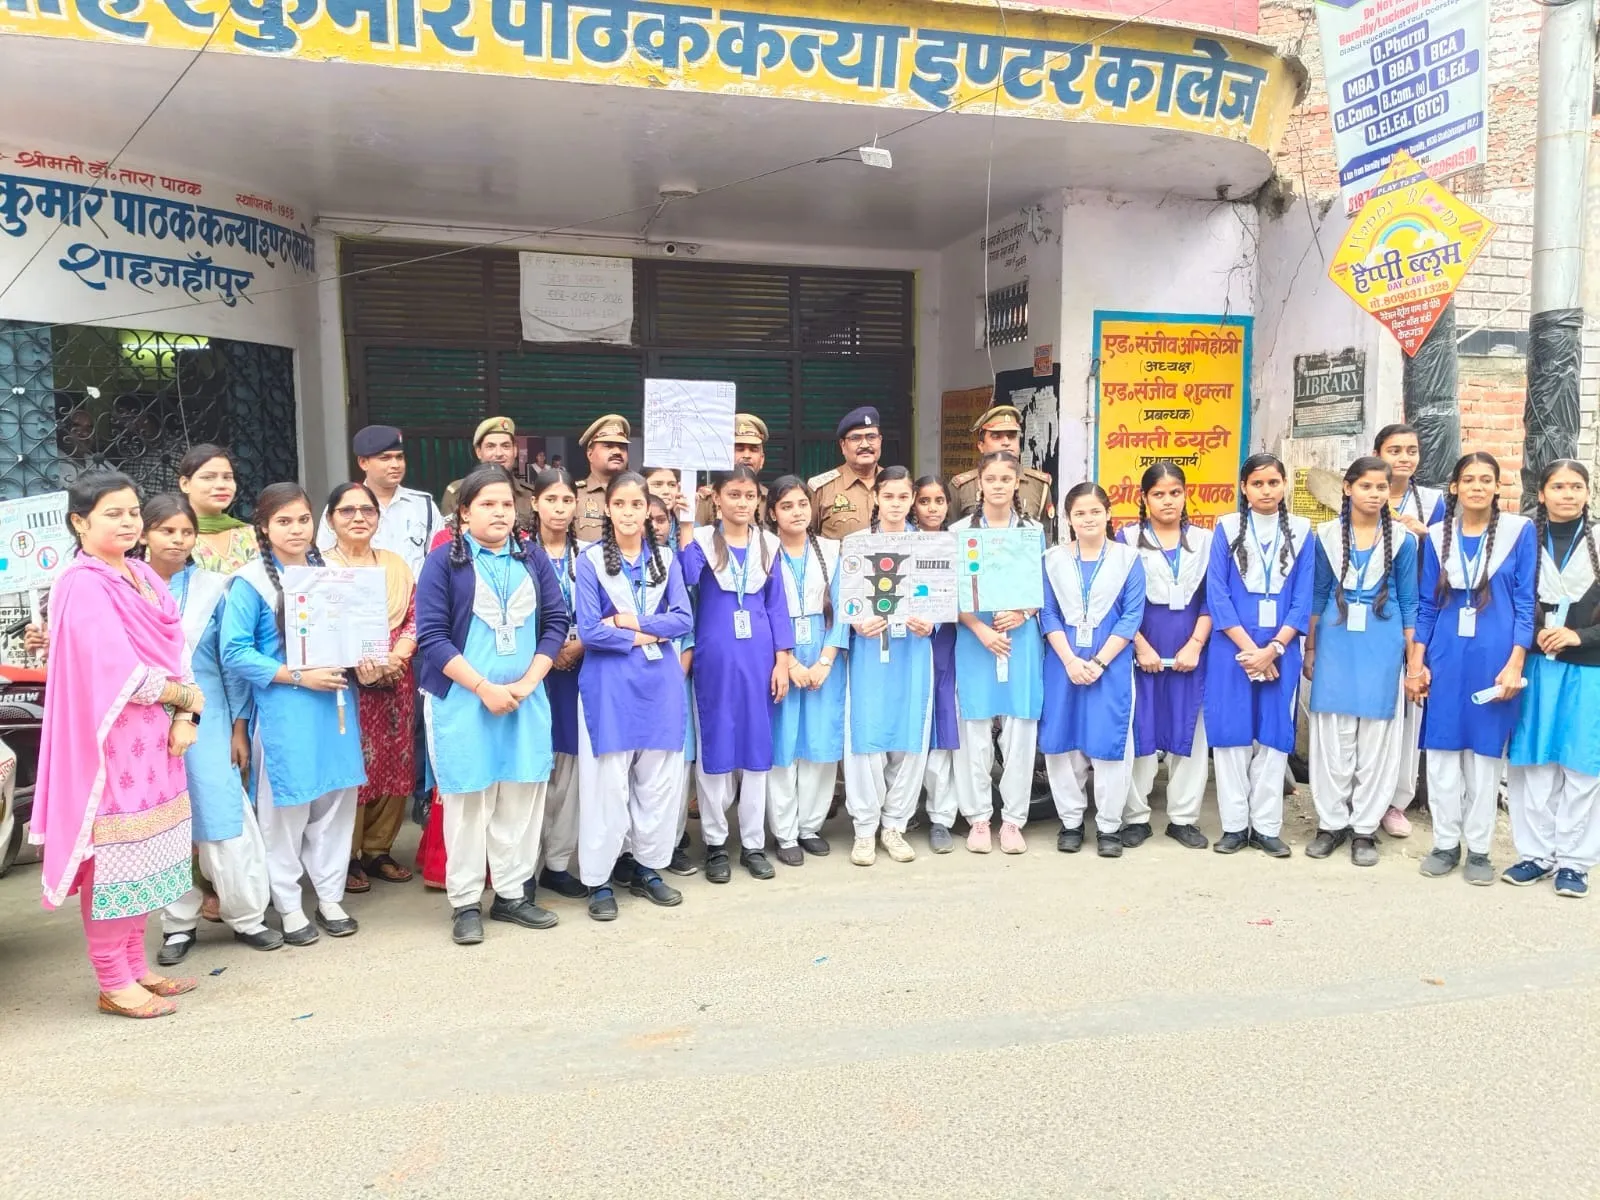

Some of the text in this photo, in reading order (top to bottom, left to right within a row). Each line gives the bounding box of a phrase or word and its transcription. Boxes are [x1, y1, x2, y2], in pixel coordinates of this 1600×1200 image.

[1373, 27, 1426, 63] D.Pharm
[489, 0, 713, 69] पाठक
[717, 11, 909, 89] कन्या
[909, 28, 1087, 109] इण्टर
[1096, 39, 1269, 126] कालेज
[1348, 36, 1457, 99] MBA BBA BCA
[1336, 104, 1377, 130] B.Com.
[1382, 86, 1415, 110] B.Com.
[1437, 58, 1470, 84] B.Ed.
[1368, 94, 1445, 142] D.El.Ed. (BTC)
[14, 151, 84, 175] श्रीमती
[119, 169, 156, 192] तारा
[160, 176, 202, 197] पाठक
[1377, 182, 1399, 196] PLAY
[111, 190, 195, 243] पाठक
[197, 206, 259, 256] कन्या
[59, 243, 255, 307] शाहजहाँपुर
[1351, 250, 1402, 293] हैप्पी
[1407, 242, 1461, 276] ब्लूम
[1387, 274, 1426, 291] DAY CARE
[1135, 330, 1179, 355] संजीव
[1178, 329, 1242, 359] अग्निहोत्री
[1140, 359, 1195, 375] (अध्यक्ष)
[1134, 376, 1178, 404] संजीव
[1184, 383, 1234, 405] शुक्ला
[1296, 371, 1362, 398] LIBRARY
[1138, 407, 1195, 424] (प्रबन्धक)
[1105, 423, 1232, 455] श्रीमती ब्यूटी
[1199, 483, 1235, 505] पाठक
